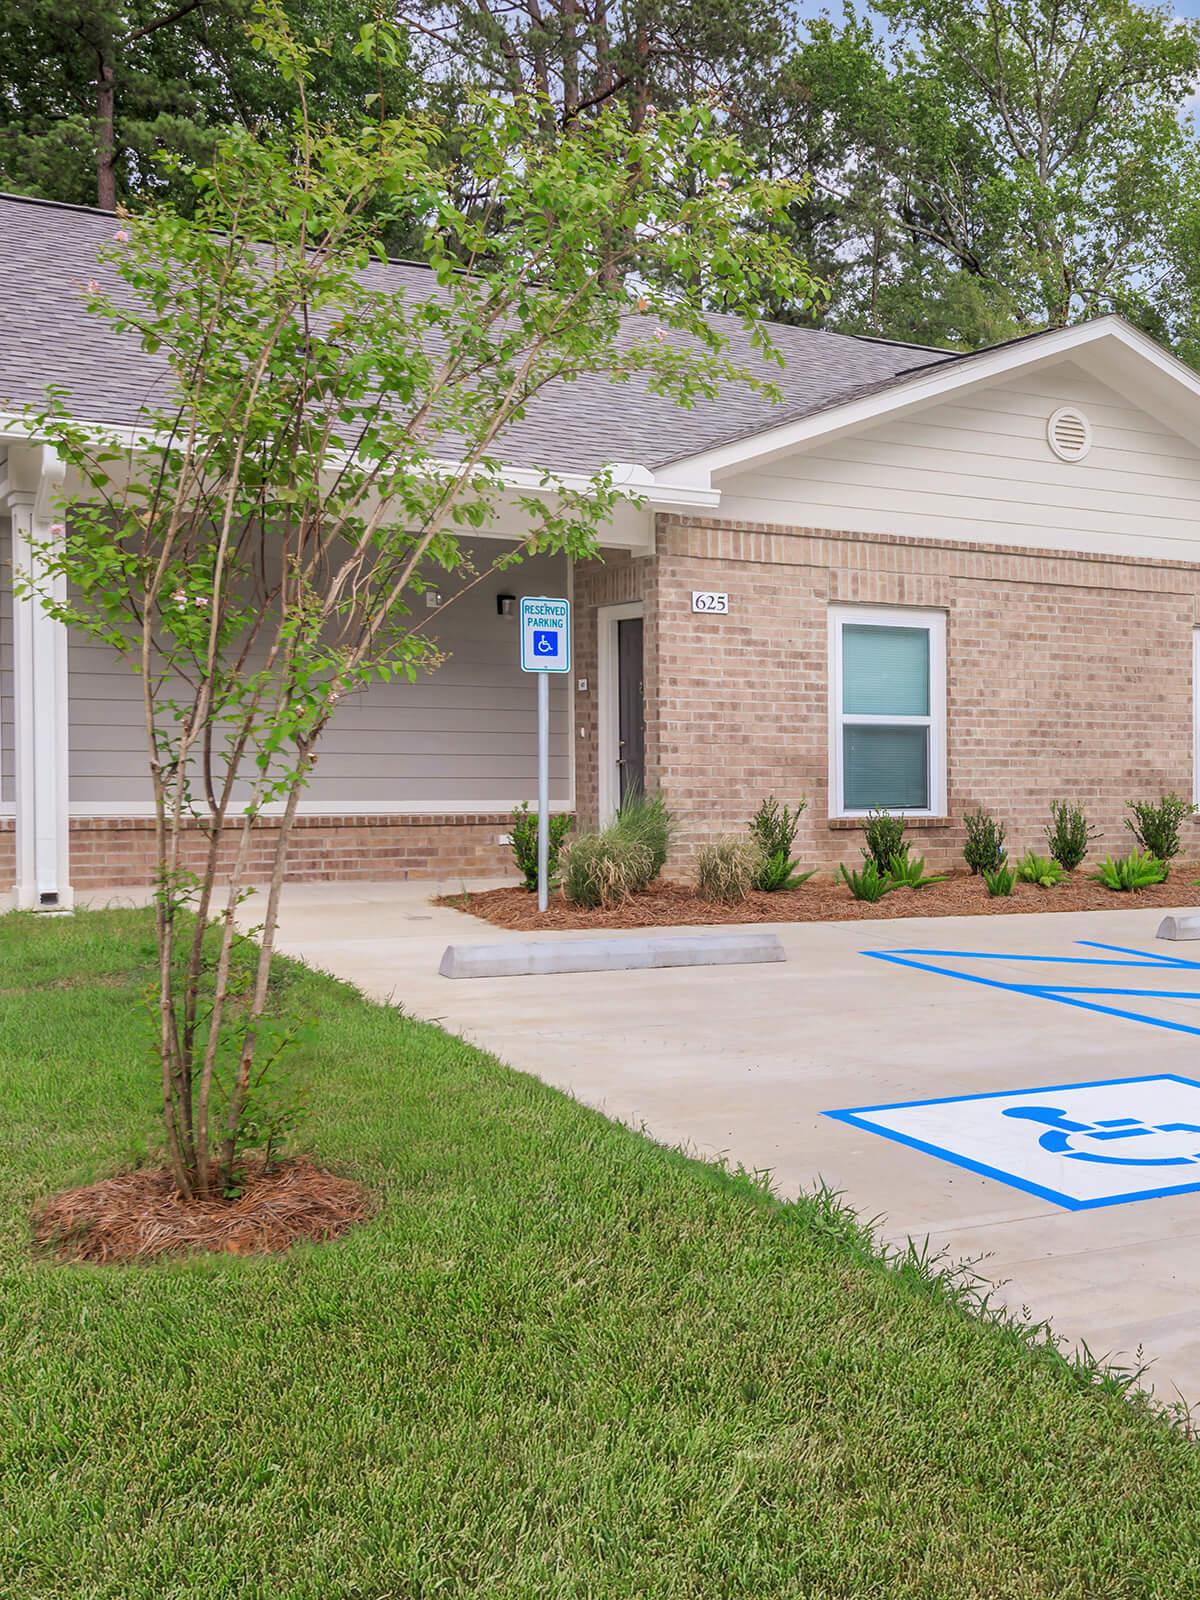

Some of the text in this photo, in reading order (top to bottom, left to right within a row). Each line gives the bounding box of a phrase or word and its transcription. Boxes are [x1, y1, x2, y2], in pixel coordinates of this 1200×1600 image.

[695, 594, 726, 611] 625
[524, 605, 566, 617] RESERVED
[528, 617, 563, 629] PARKING
